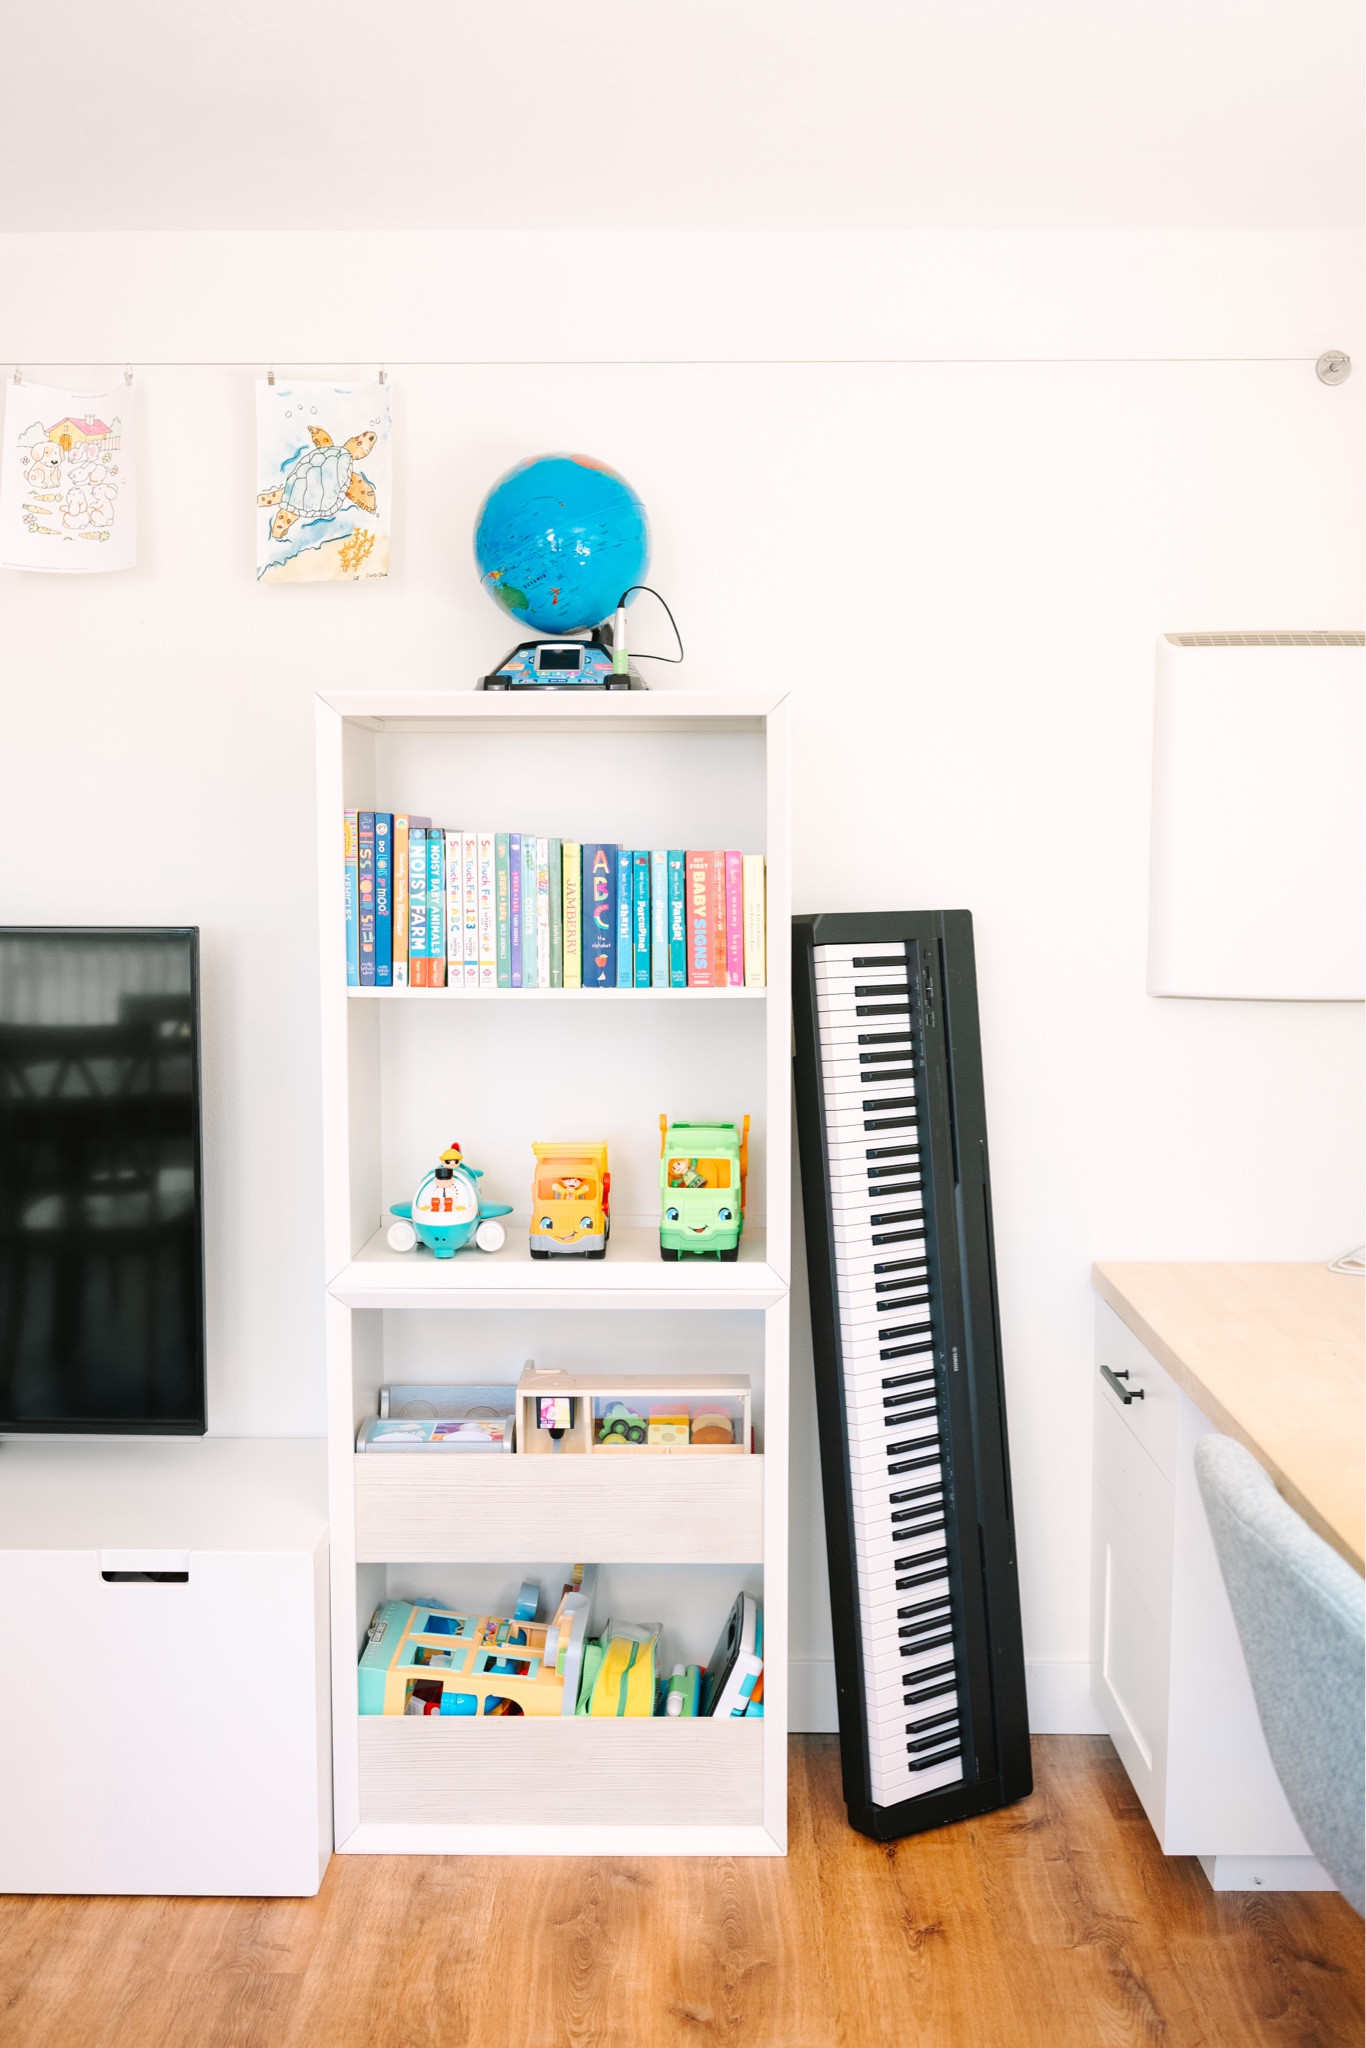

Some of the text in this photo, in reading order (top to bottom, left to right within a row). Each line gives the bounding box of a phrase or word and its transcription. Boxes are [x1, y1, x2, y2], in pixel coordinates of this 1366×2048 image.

[411, 845, 425, 950] NOISY FARM
[430, 845, 440, 954] NOISY BABY ANIMALS
[451, 885, 459, 903] Feel
[466, 885, 474, 903] Feel
[482, 889, 490, 910] Feel
[525, 897, 534, 935] colors
[693, 872, 706, 917] BABY
[566, 879, 577, 956] JAMBERRY
[694, 919, 708, 969] SIGNS
